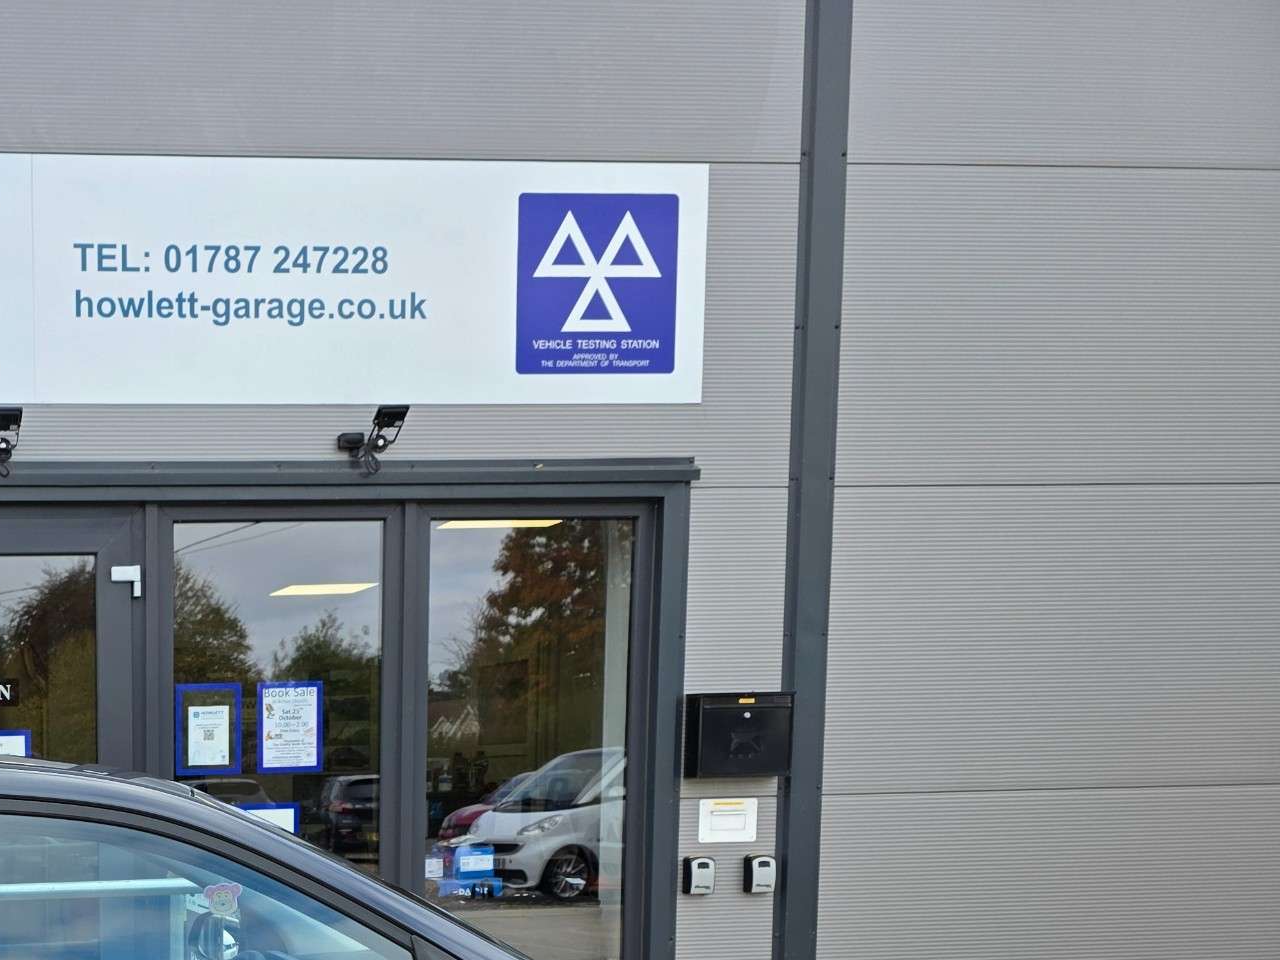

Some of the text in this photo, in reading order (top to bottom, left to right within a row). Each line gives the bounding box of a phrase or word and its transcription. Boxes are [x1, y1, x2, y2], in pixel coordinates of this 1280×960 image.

[72, 243, 389, 275] TEL: 01787 247228
[75, 290, 427, 327] howlett-garage.co.uk
[532, 339, 660, 350] VEHICLE TESTING STATION
[264, 687, 315, 698] Book Sale
